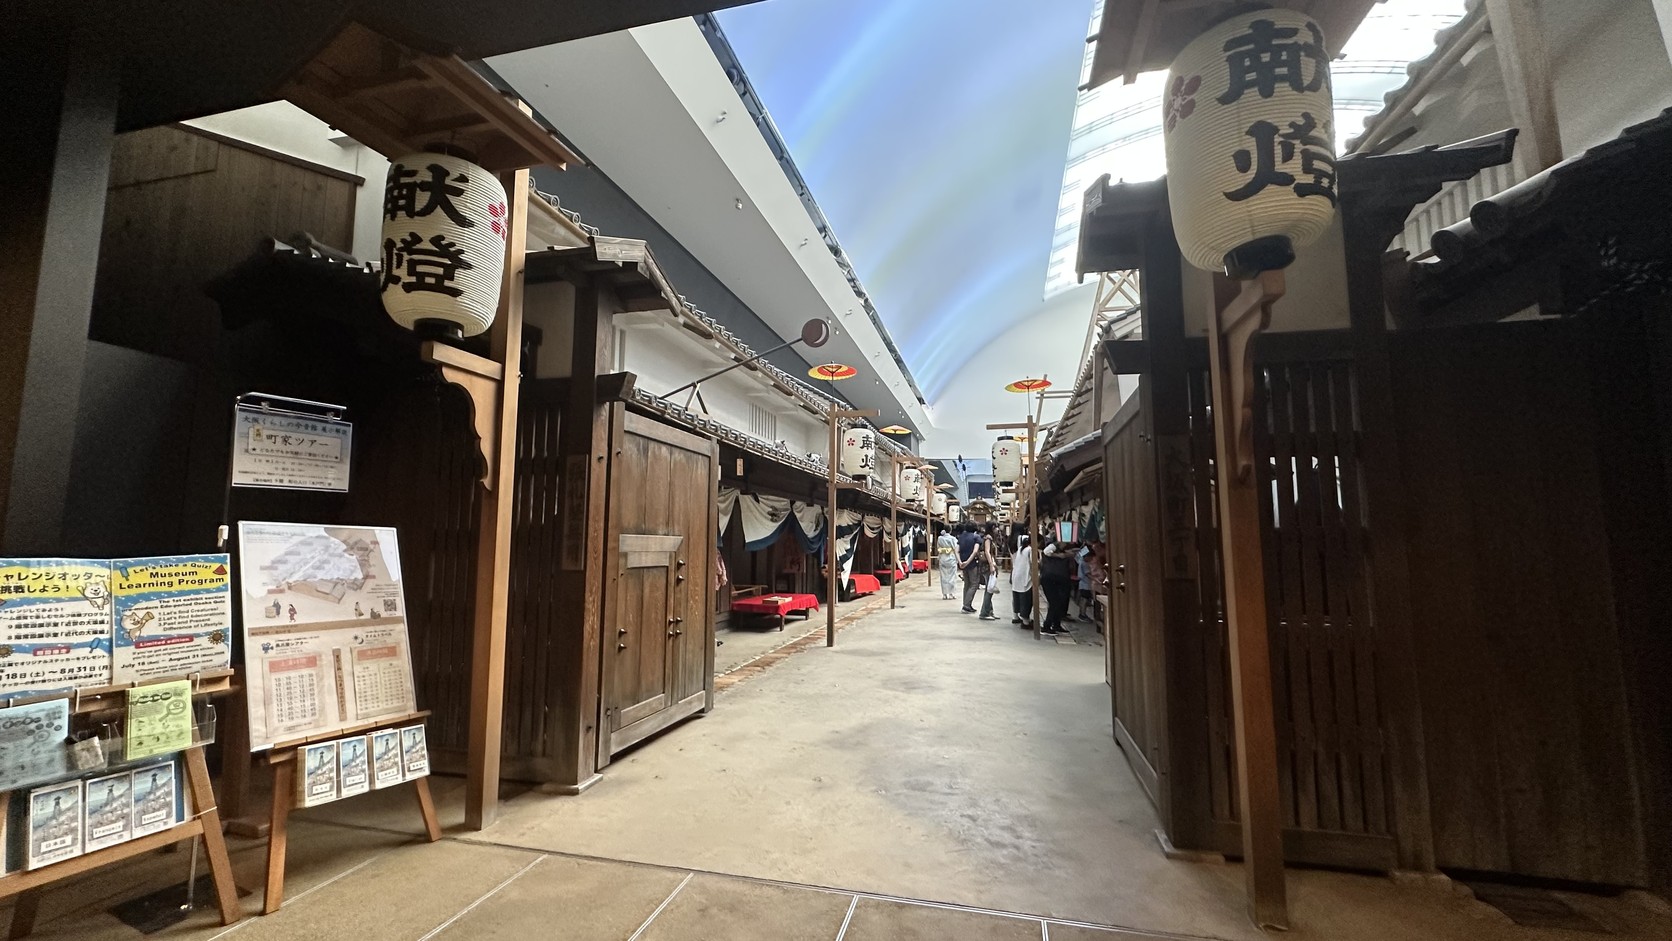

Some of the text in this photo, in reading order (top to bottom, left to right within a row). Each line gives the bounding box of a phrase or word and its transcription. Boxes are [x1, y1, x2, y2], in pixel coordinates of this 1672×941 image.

[266, 434, 328, 447] 町家ツアー
[133, 564, 156, 574] Let's
[150, 570, 198, 579] Museum
[119, 578, 224, 590] Learning Program
